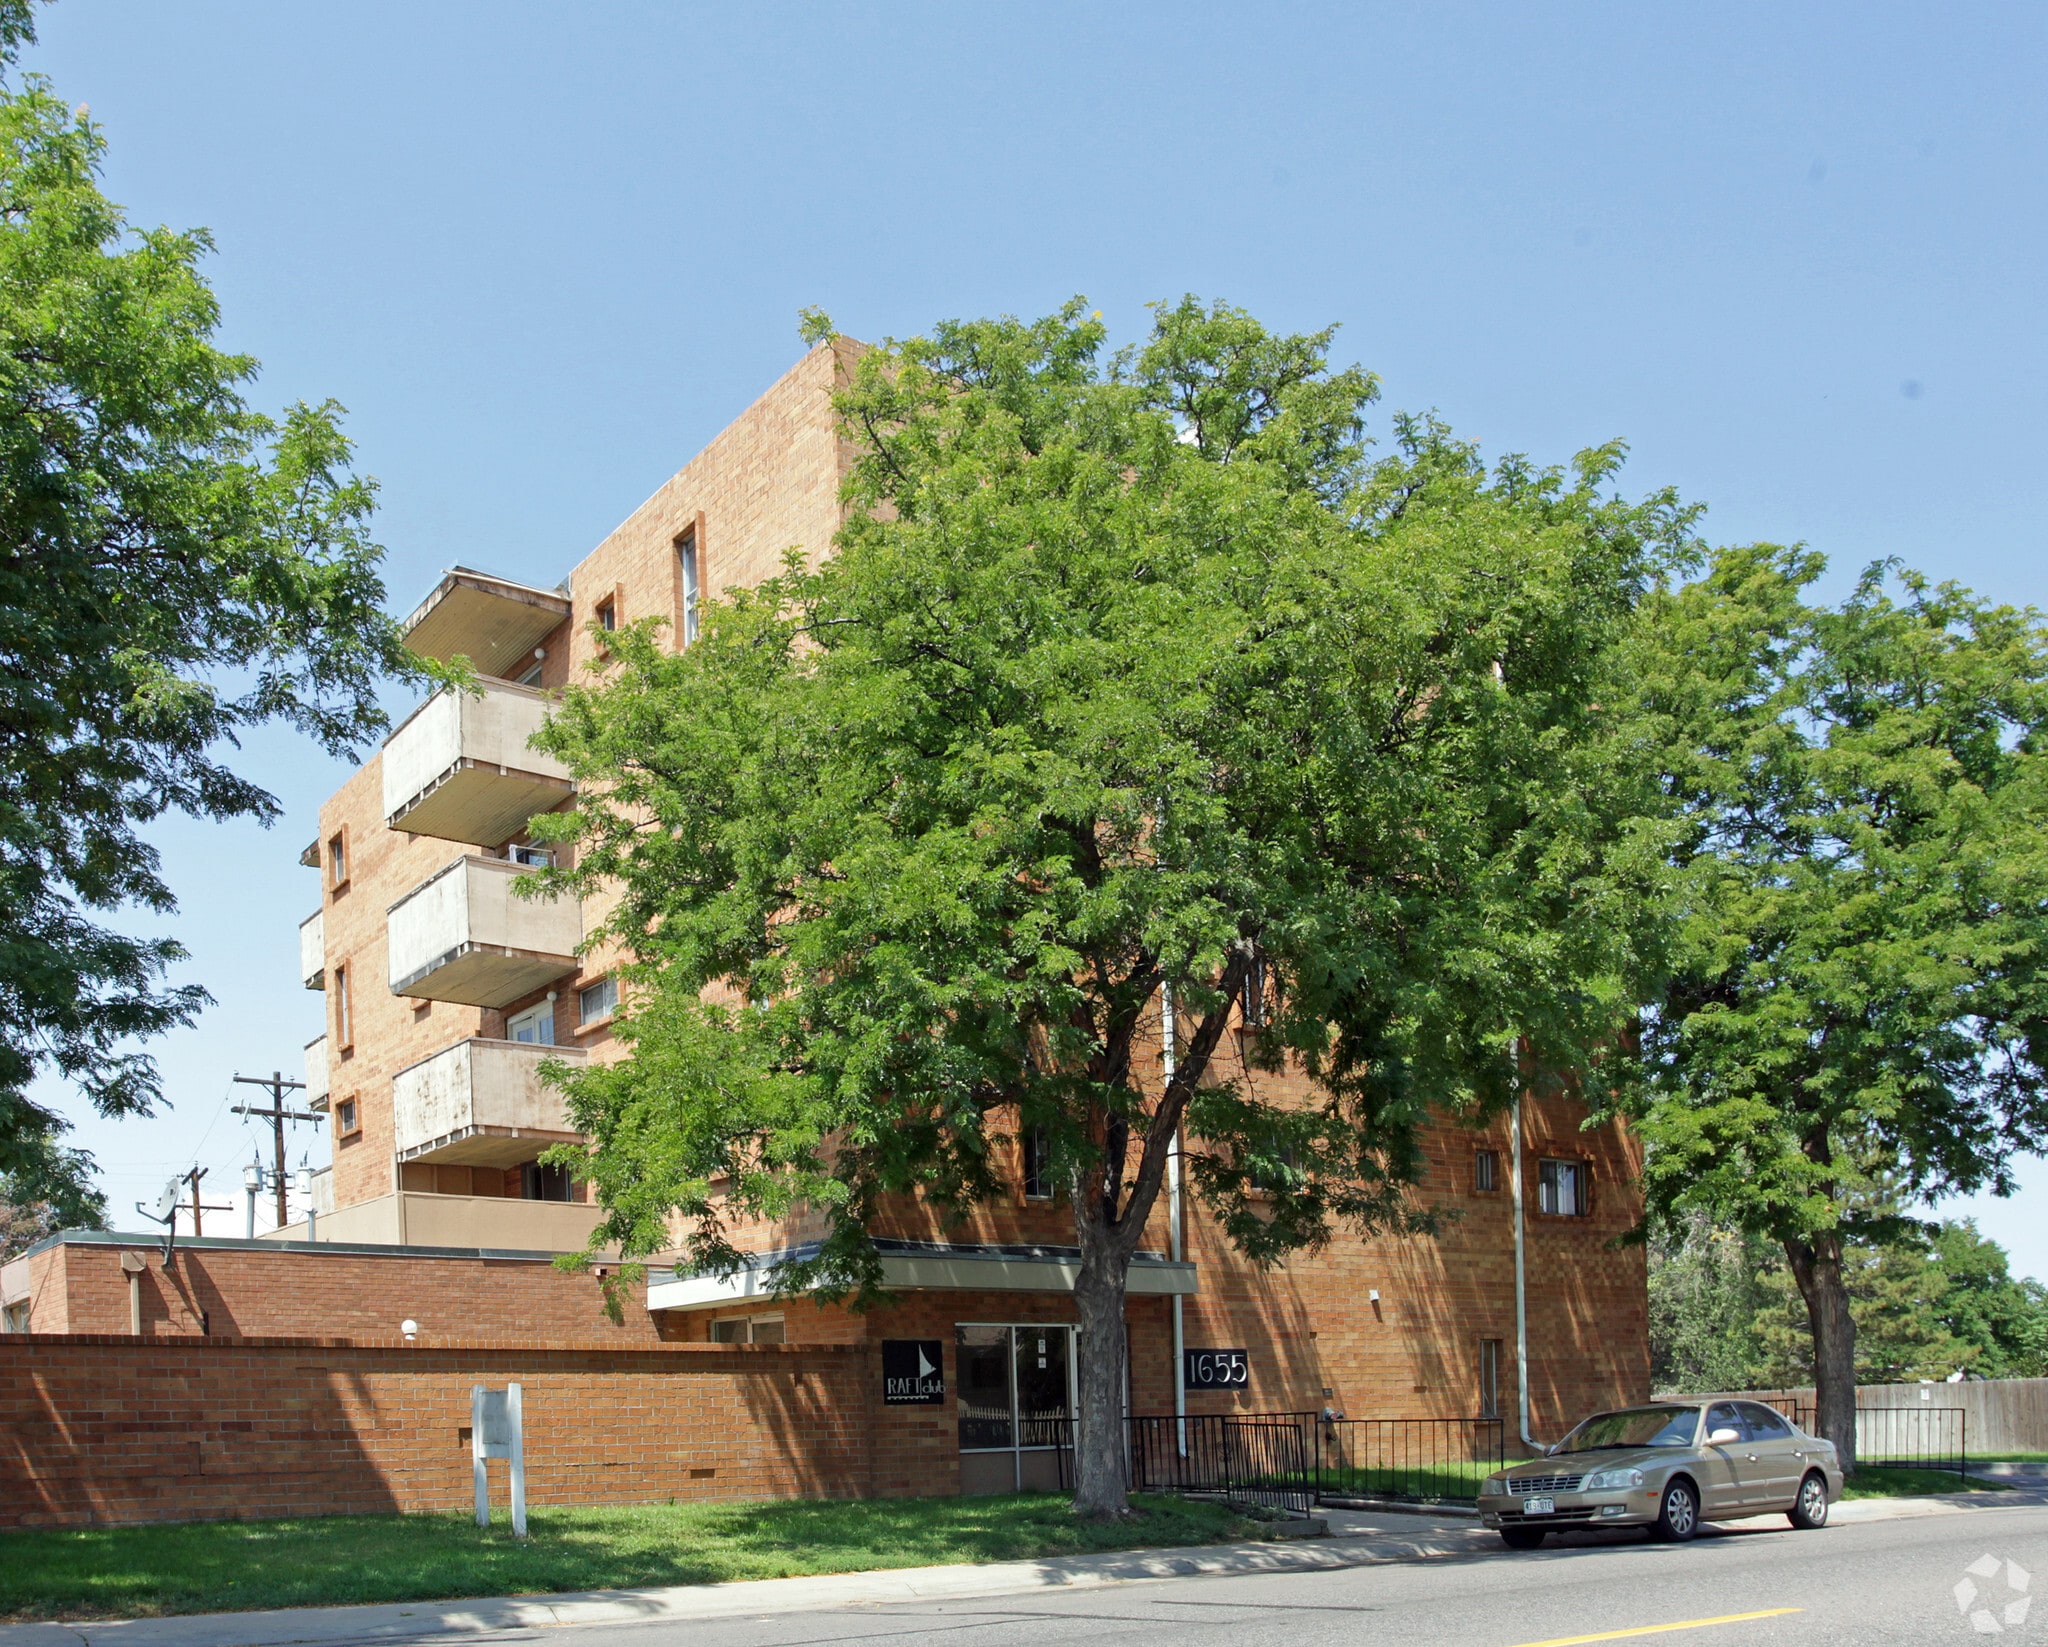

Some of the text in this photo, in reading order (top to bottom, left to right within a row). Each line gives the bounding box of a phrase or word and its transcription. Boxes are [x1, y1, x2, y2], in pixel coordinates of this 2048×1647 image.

[1190, 1354, 1247, 1383] 1655
[887, 1377, 947, 1395] RAFT club
